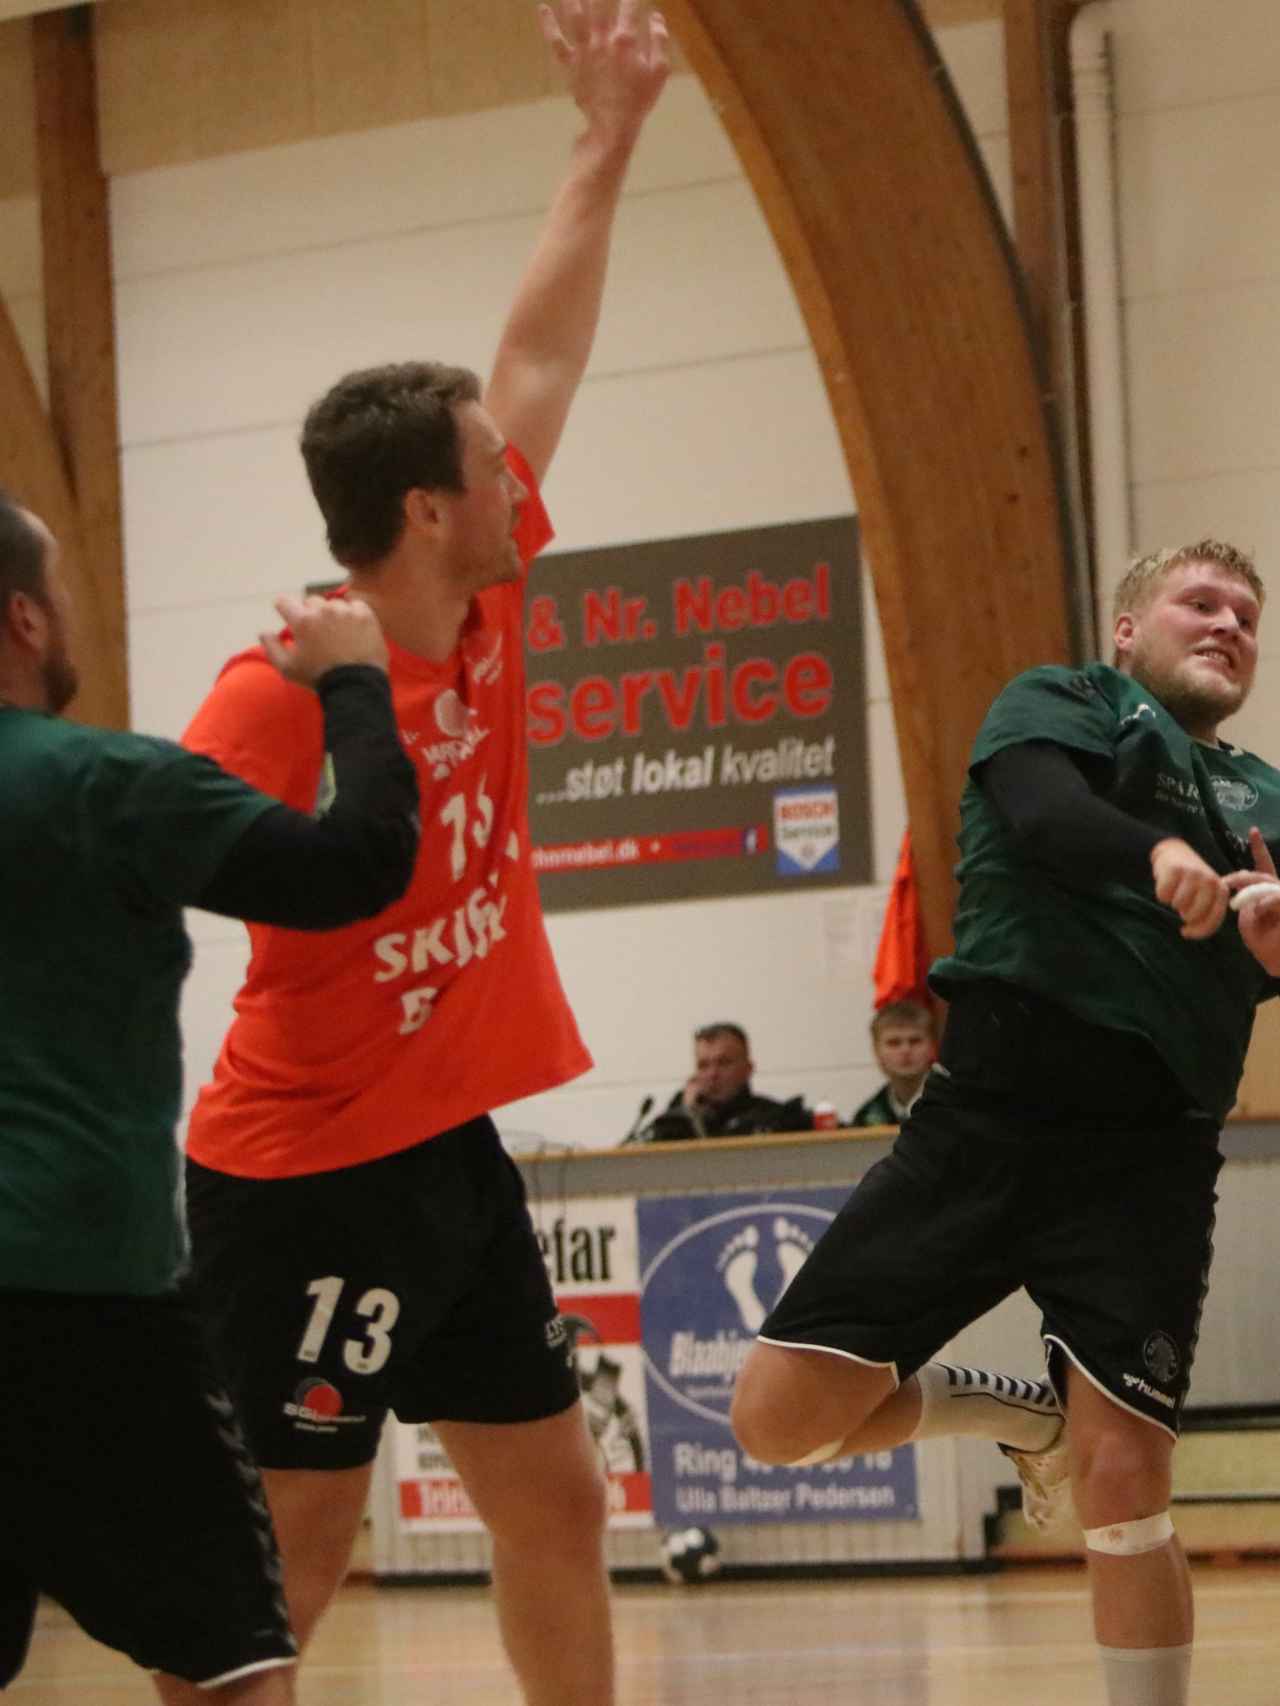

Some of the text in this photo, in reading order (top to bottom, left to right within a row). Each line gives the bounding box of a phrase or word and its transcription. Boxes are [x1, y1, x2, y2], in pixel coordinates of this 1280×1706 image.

[527, 562, 831, 652] & Nr. Nebel
[526, 643, 833, 748] service
[631, 743, 714, 795] lokal
[720, 734, 836, 784] kvalitet
[297, 1275, 400, 1375] 13
[674, 1440, 738, 1483] Ring
[675, 1485, 718, 1514] Ulla
[794, 1481, 896, 1510] Pedersen
